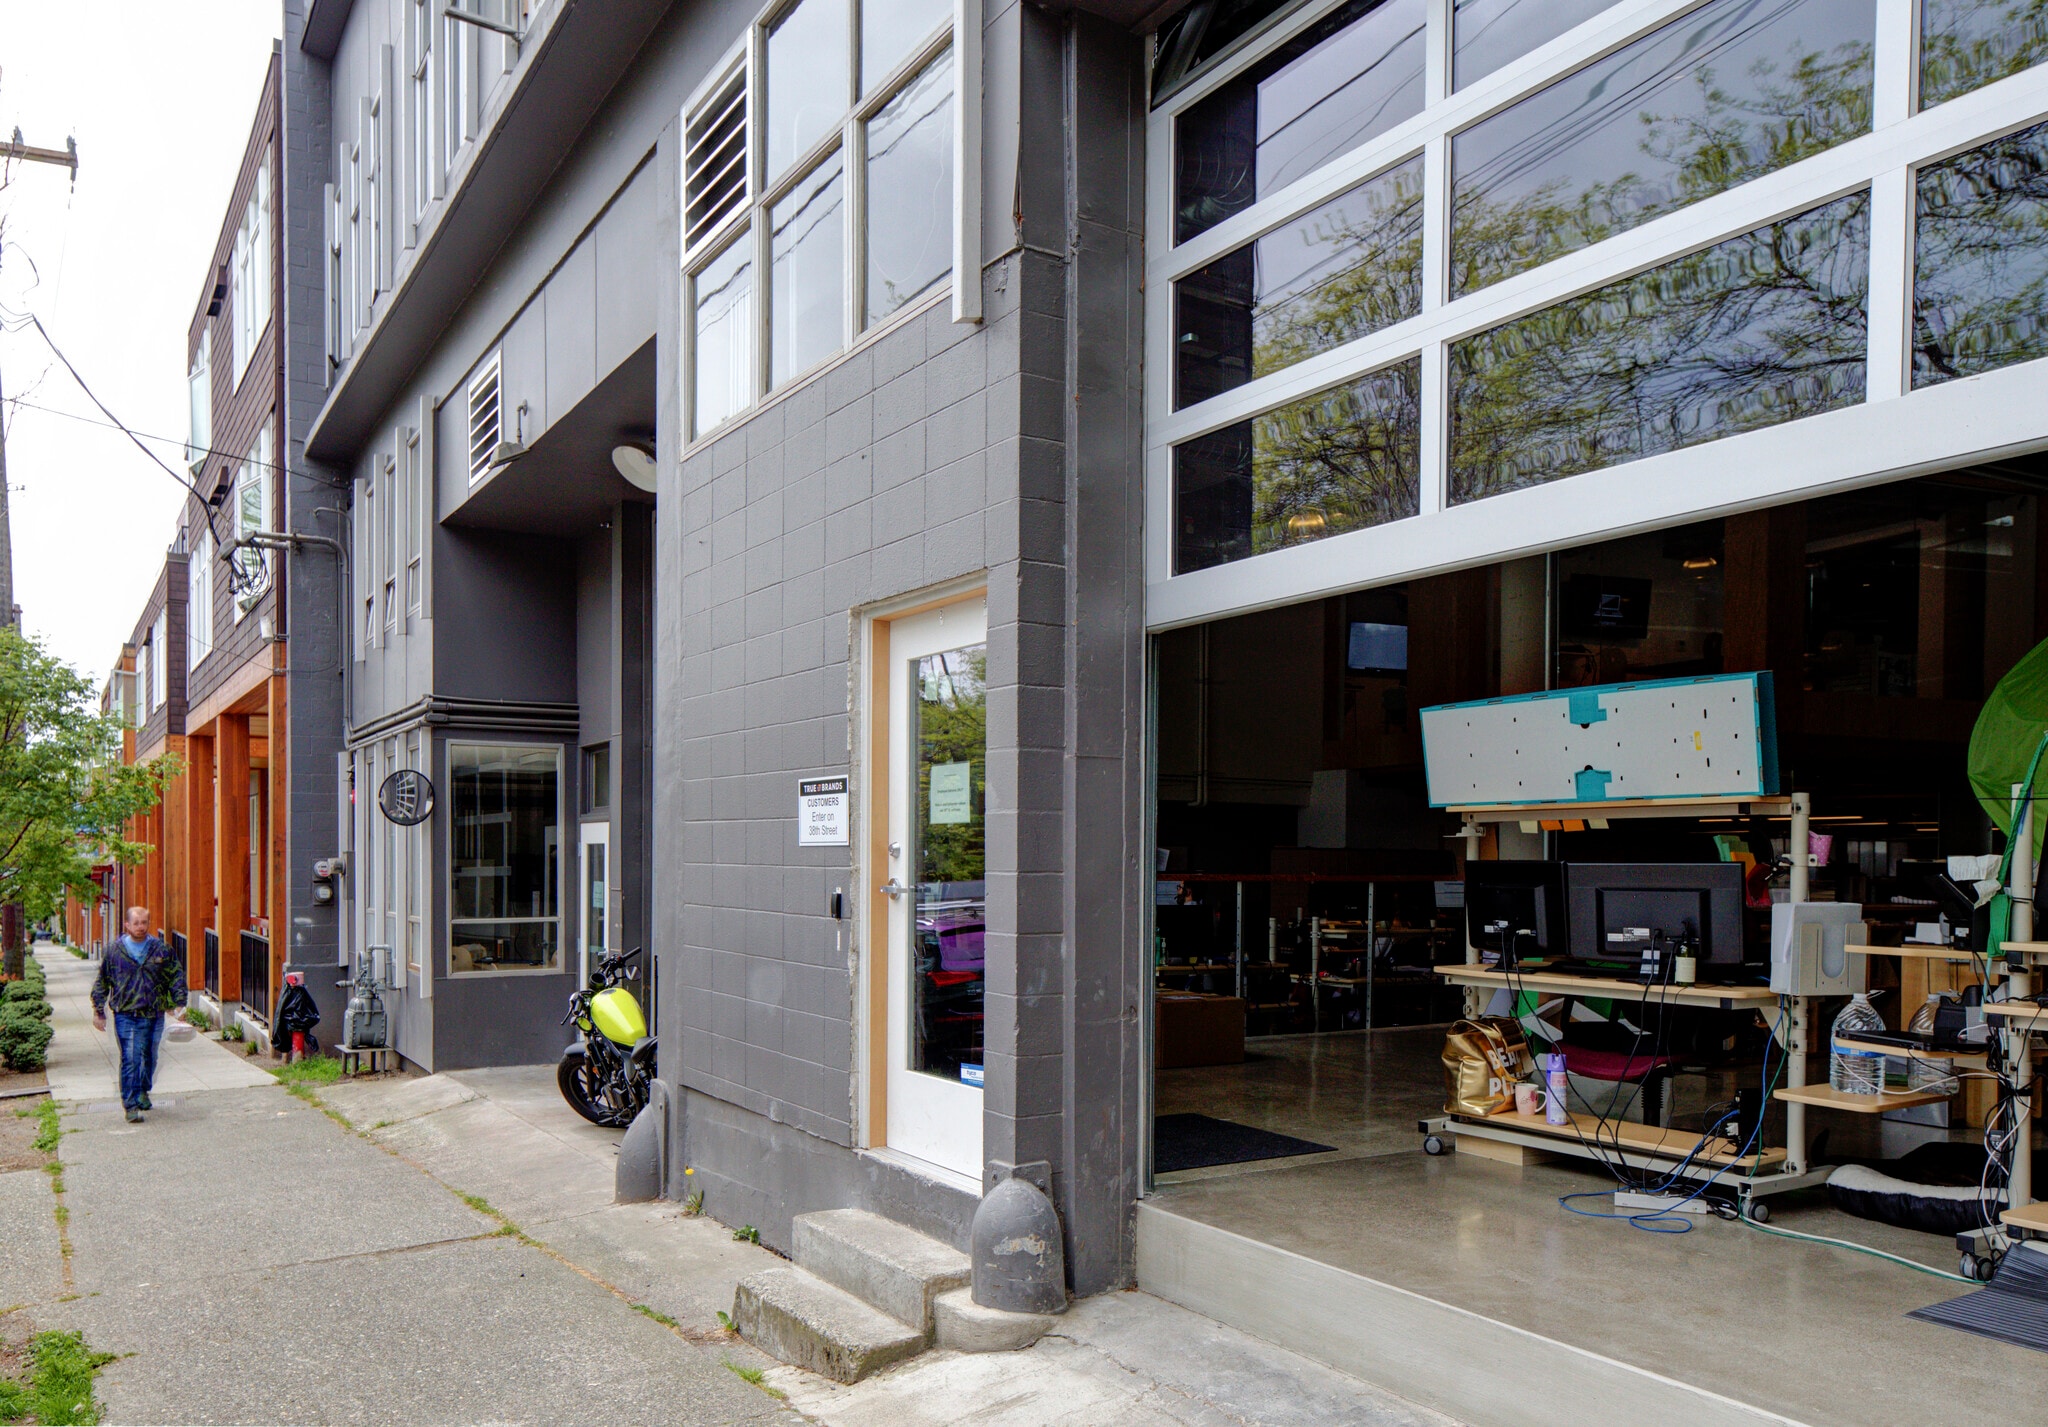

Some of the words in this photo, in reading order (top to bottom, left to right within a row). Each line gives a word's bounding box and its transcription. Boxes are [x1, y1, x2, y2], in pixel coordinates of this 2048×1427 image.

[804, 784, 817, 793] TRUE
[822, 782, 843, 792] BRANDS
[807, 797, 839, 807] CUSTOMERS
[812, 811, 826, 822] Enter
[827, 813, 834, 822] on
[821, 825, 838, 836] Street
